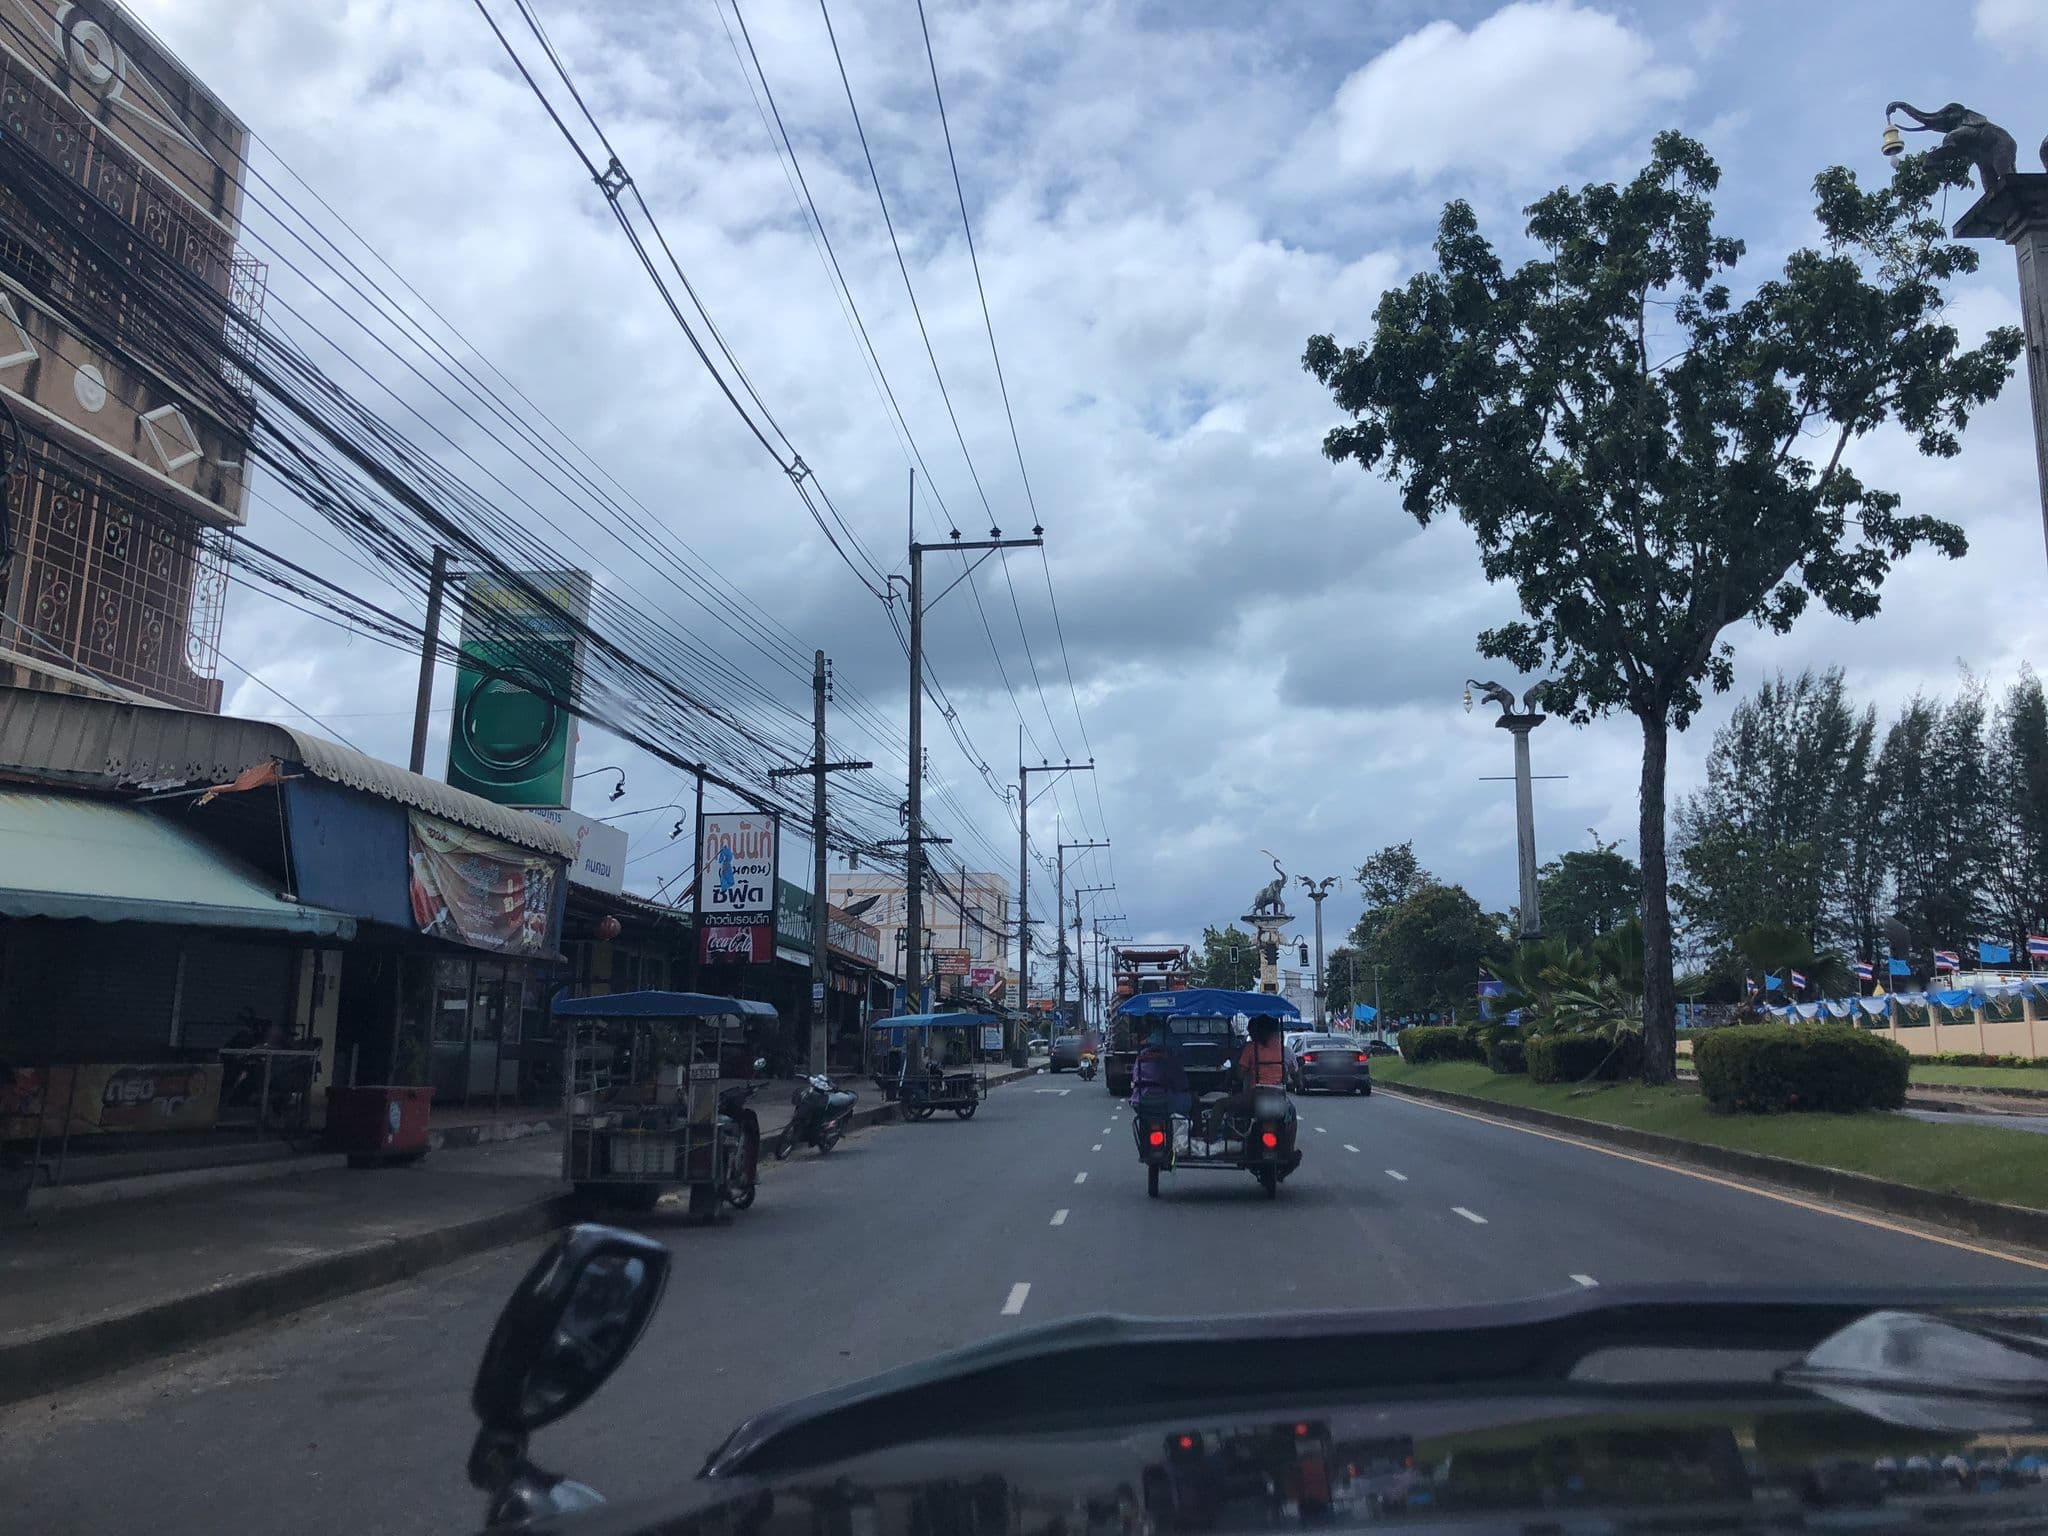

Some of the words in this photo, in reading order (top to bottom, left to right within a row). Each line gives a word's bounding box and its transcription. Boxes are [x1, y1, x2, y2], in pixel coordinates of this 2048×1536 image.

[705, 912, 769, 925] ข้าวต้มรอบดึก
